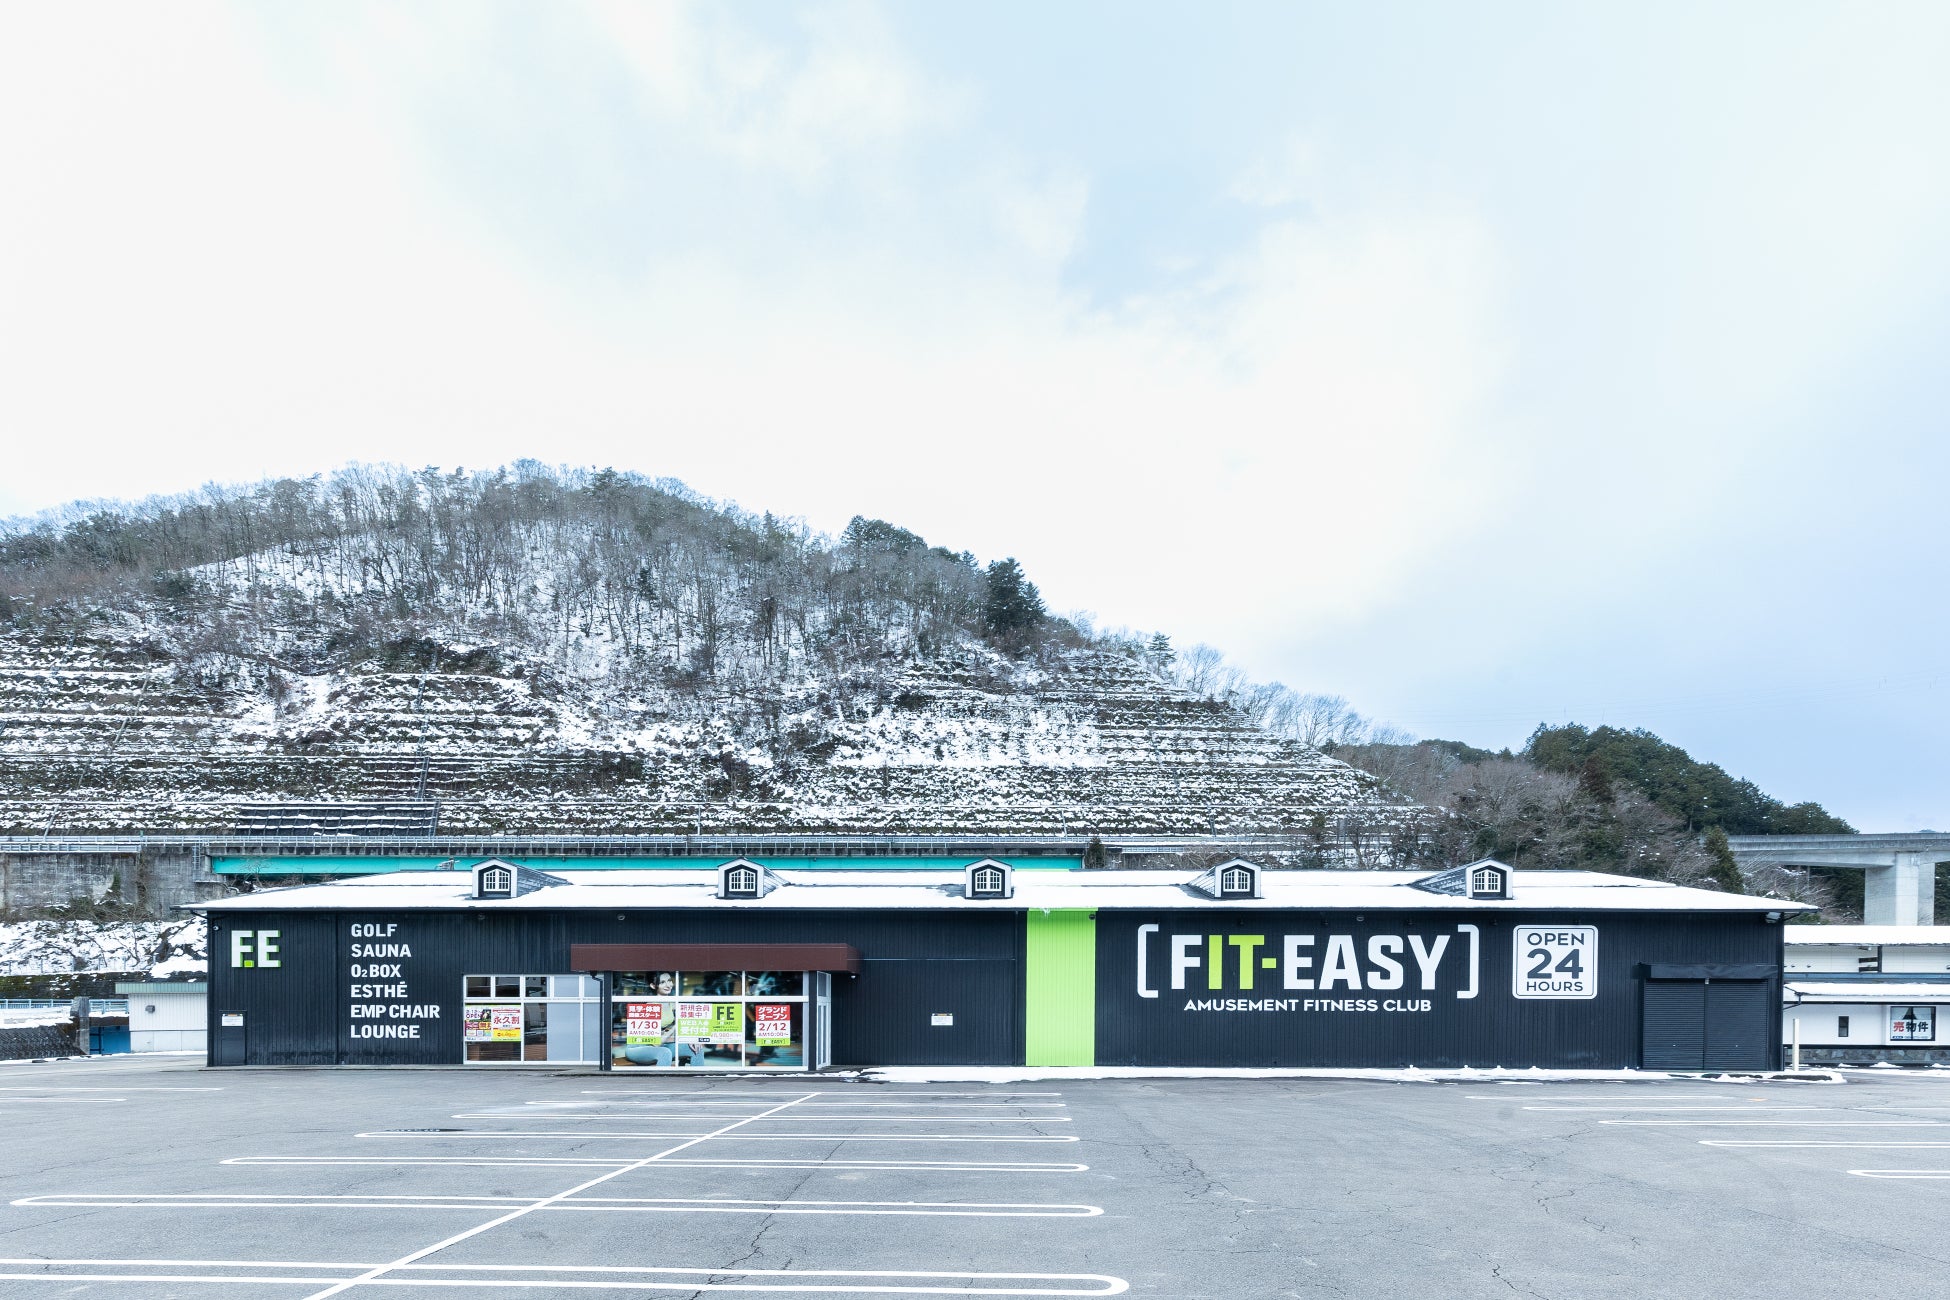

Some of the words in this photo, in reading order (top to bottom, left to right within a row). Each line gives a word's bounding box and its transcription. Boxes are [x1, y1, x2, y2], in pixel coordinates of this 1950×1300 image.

[351, 923, 398, 937] GOLF
[1527, 932, 1585, 946] OPEN
[351, 943, 412, 957] SAUNA
[1527, 948, 1584, 979] 24
[351, 981, 408, 998] ESTHÉ
[1526, 981, 1584, 992] HOURS
[351, 1004, 387, 1018] EMP
[389, 1004, 441, 1018] CHAIR
[758, 1006, 787, 1014] グランド
[1184, 999, 1299, 1012] AMUSEMENT
[1304, 999, 1379, 1012] FITNESS
[1383, 999, 1432, 1012] CLUB
[351, 1024, 421, 1039] LOUNGE
[630, 1021, 659, 1030] 1/30
[759, 1022, 787, 1031] 2/12
[1893, 1021, 1929, 1032] 売物件
